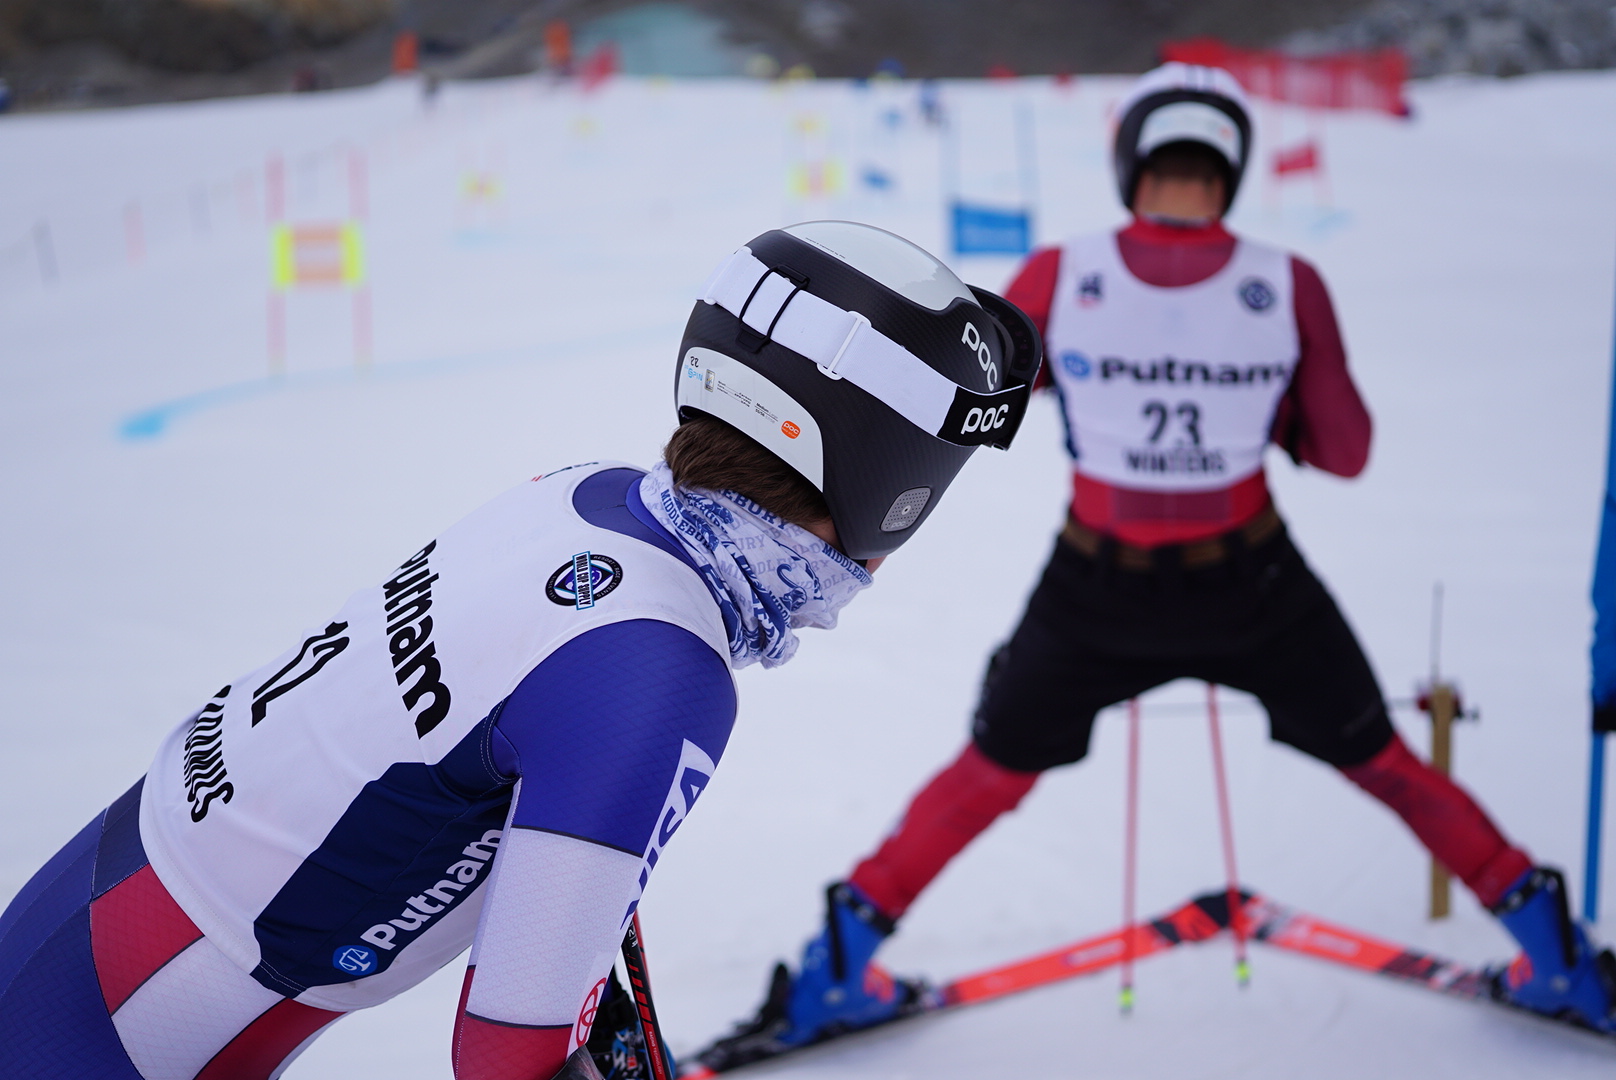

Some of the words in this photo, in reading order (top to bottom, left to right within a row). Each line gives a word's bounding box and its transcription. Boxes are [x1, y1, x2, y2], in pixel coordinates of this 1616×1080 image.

[1100, 355, 1285, 386] Putnam
[1143, 401, 1202, 448] 23
[1126, 449, 1227, 472] WINTERS
[577, 583, 591, 605] SUPPLY
[360, 829, 503, 950] Putnam
